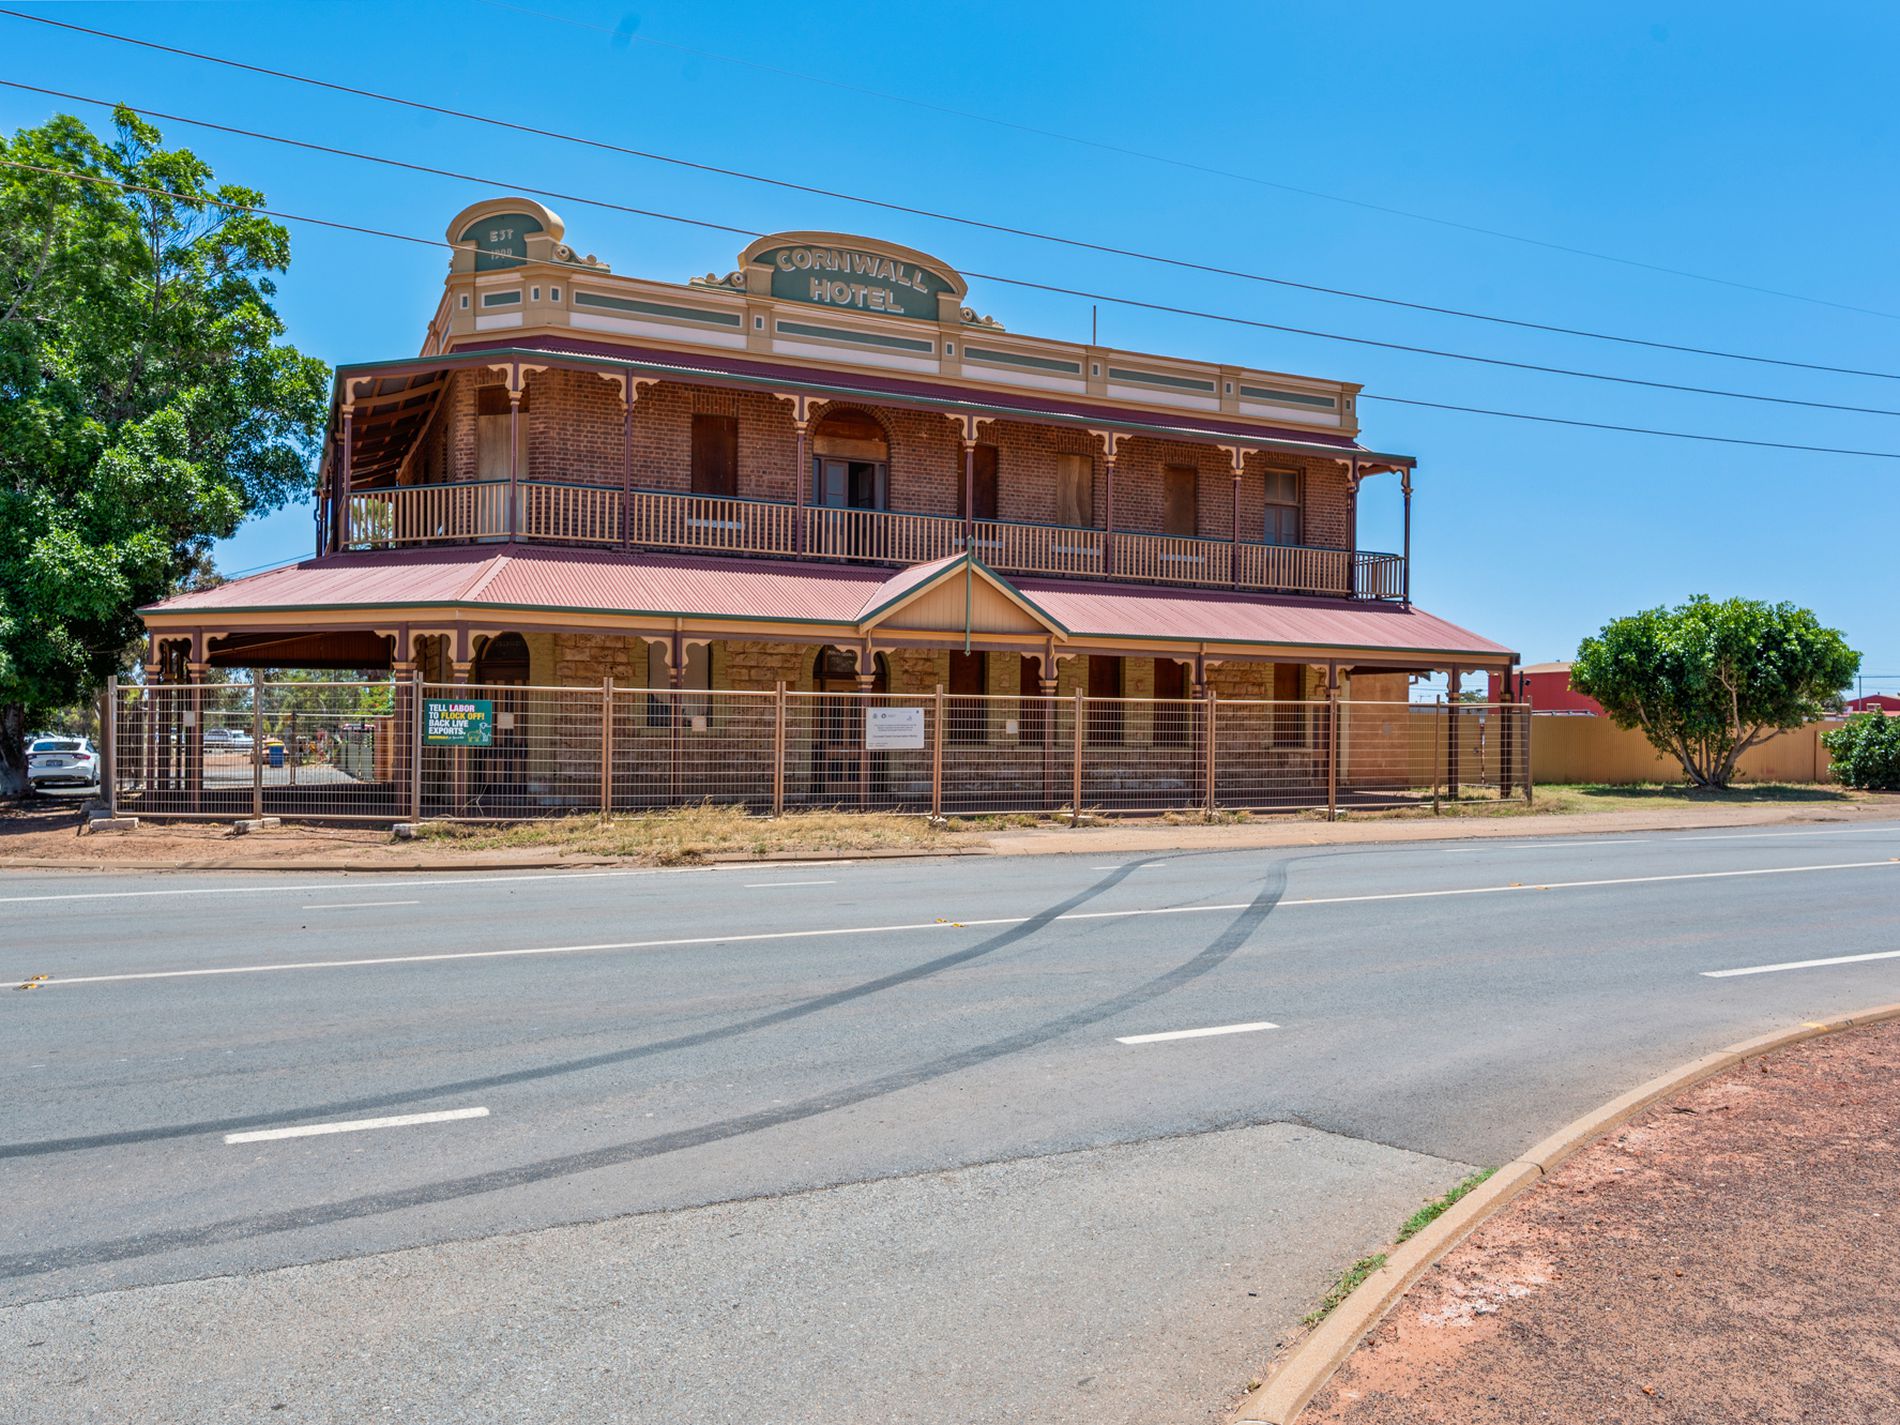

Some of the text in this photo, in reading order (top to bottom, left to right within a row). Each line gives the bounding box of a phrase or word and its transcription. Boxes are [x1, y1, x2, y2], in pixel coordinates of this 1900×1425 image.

[489, 227, 514, 242] EST
[775, 248, 929, 294] CORNWALL
[810, 277, 905, 314] HOTEL
[429, 704, 475, 712] TELL LABOR
[441, 712, 466, 720] FLOCK
[467, 712, 485, 720] OFF!
[429, 719, 469, 728] BACK LIVE
[428, 727, 466, 735] EXPORTS.
